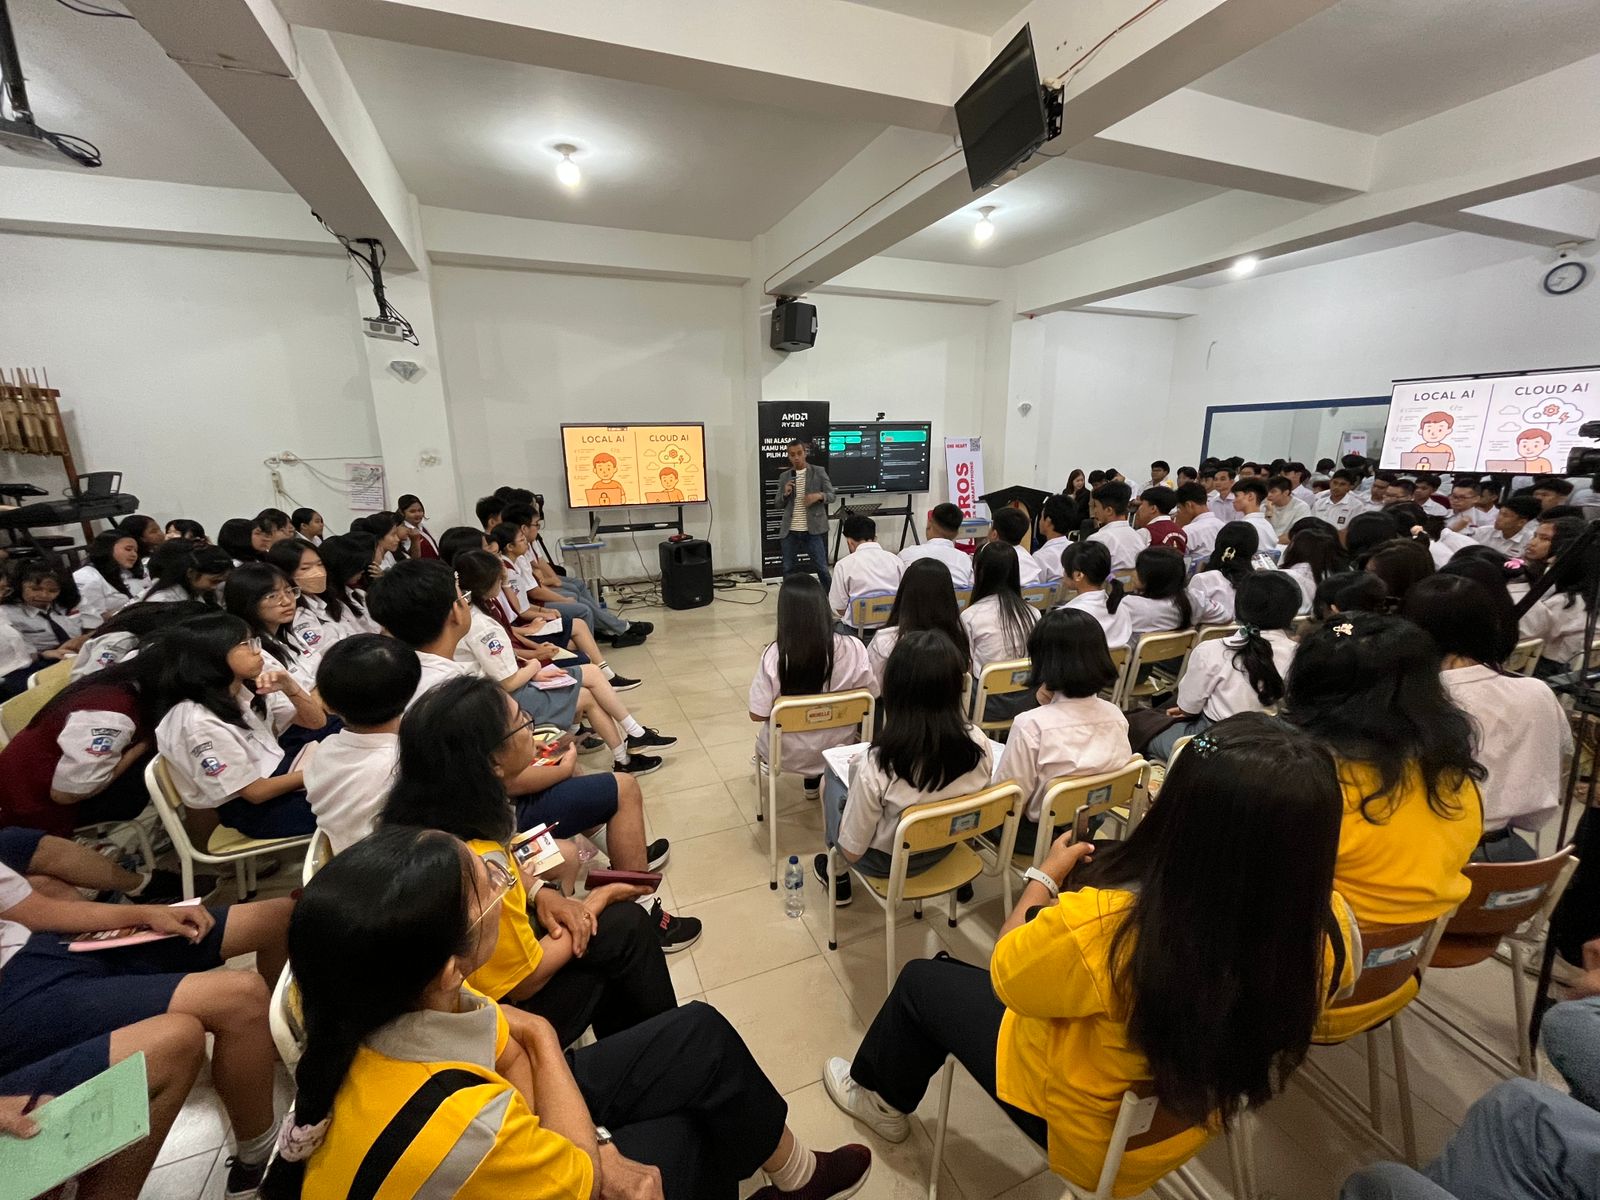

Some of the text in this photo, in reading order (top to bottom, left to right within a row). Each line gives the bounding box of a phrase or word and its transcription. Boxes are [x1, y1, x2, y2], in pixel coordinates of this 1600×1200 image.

[1514, 383, 1589, 396] CLOUD AI
[1413, 389, 1475, 402] LOCAL AI
[781, 413, 801, 421] AMD
[582, 435, 625, 443] LOCAL AI
[649, 434, 678, 442] CLOUD
